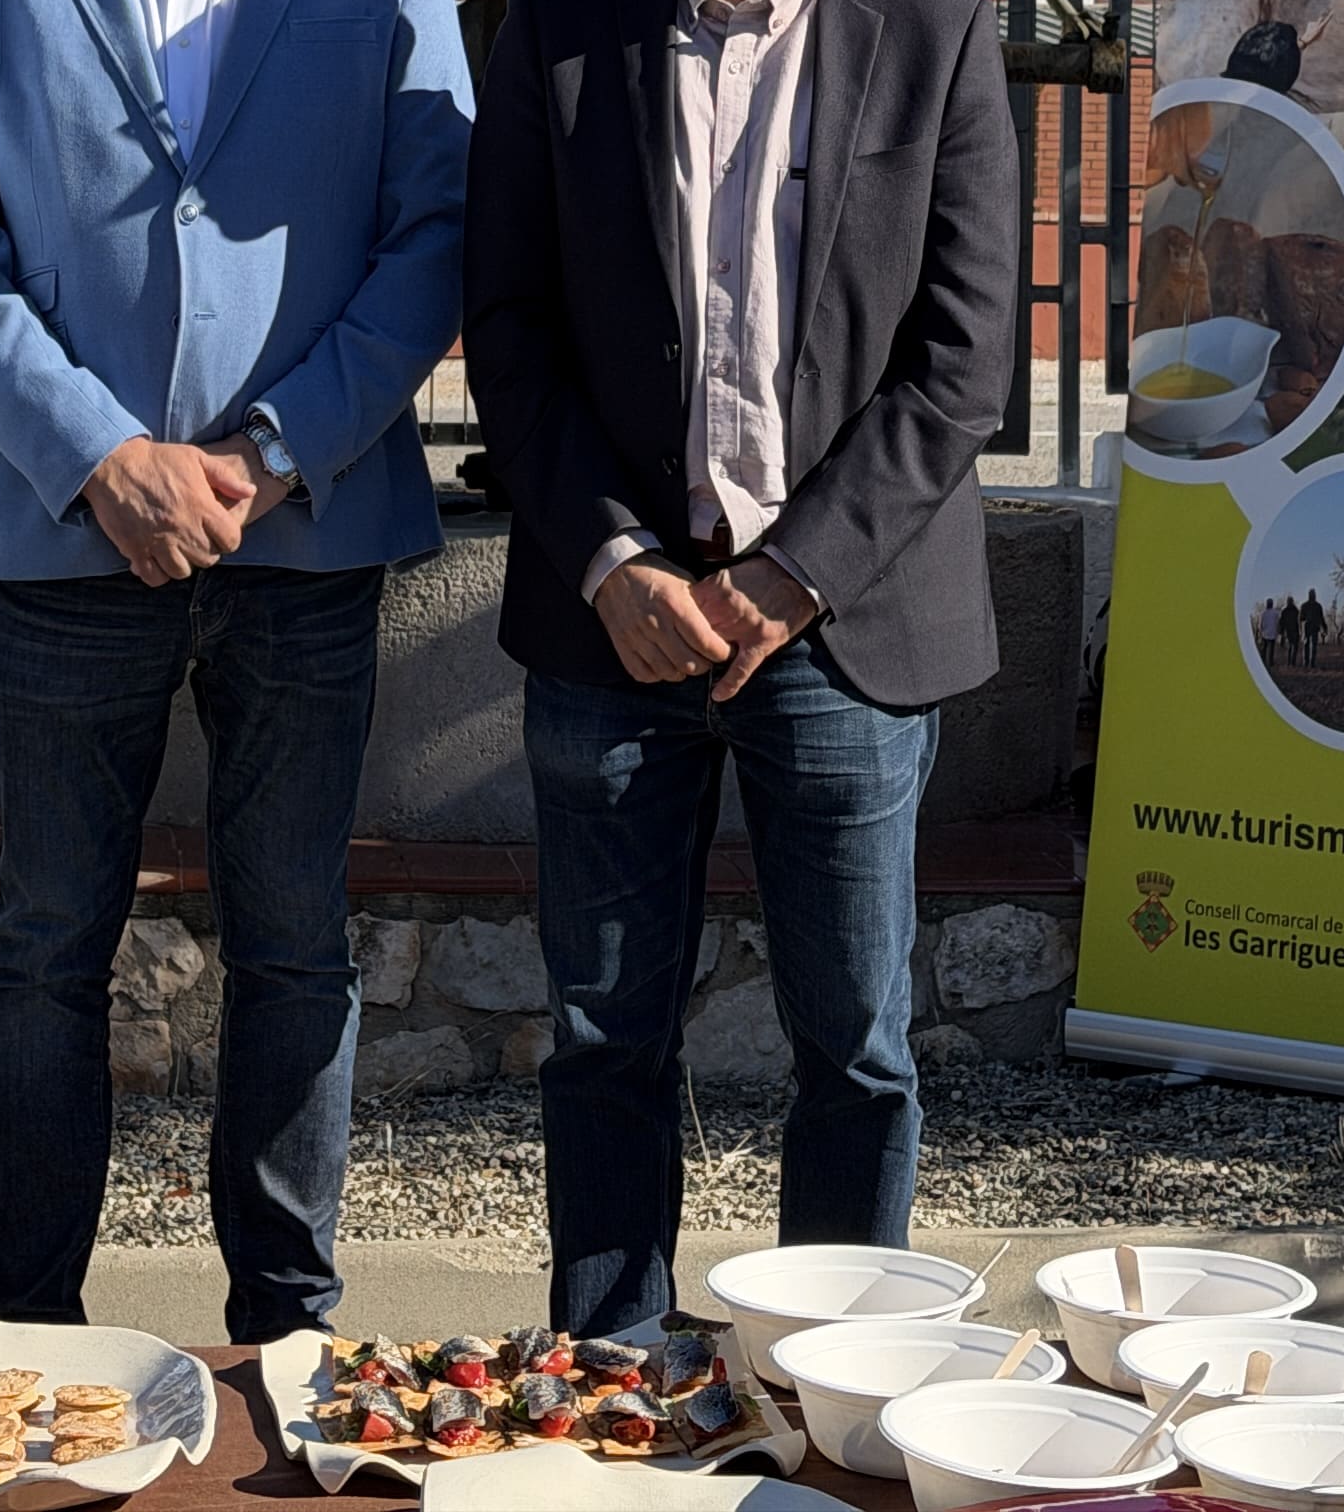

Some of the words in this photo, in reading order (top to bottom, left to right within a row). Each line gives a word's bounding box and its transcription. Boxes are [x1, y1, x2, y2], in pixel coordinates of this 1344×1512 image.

[1184, 899, 1241, 922] Consell
[1244, 906, 1319, 932] Comarcal
[1322, 916, 1344, 935] de
[1184, 921, 1221, 951] les
